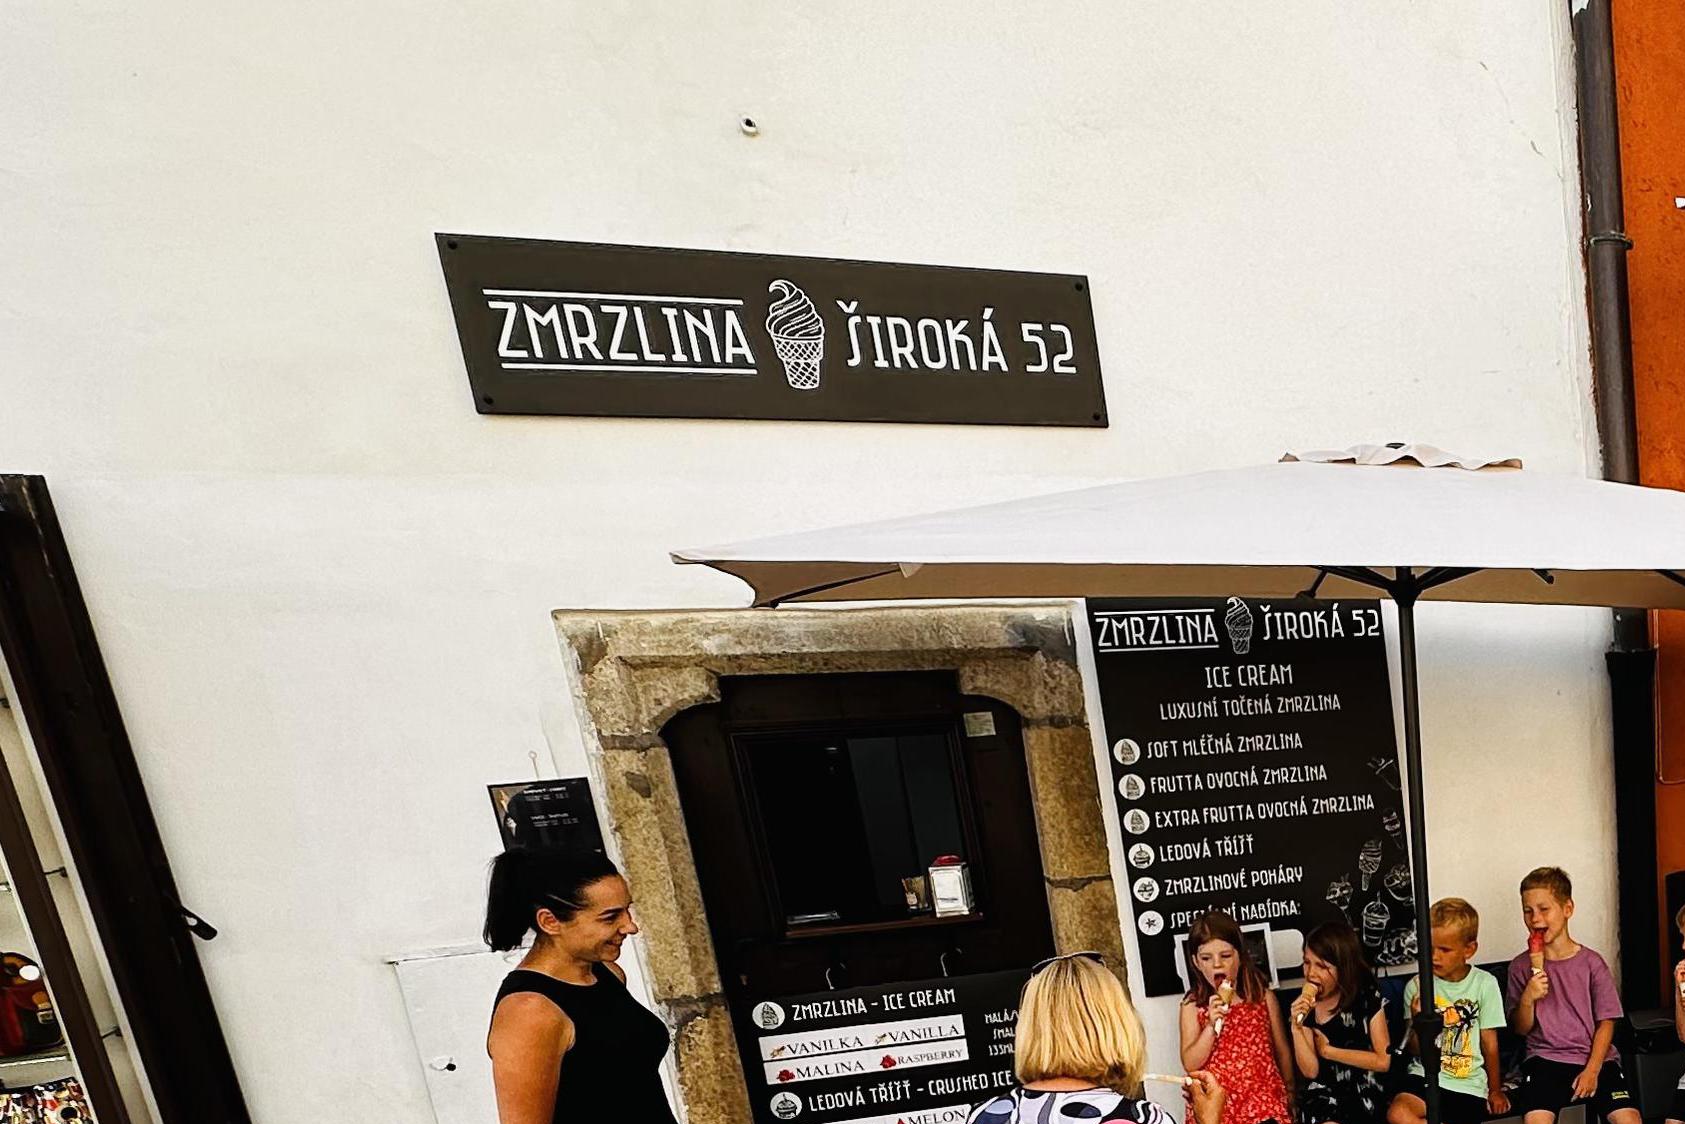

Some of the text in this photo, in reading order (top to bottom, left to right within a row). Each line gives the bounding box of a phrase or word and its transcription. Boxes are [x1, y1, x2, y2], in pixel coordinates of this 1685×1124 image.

[486, 298, 1077, 374] ZMRZLINA ŠIROKÁ 52
[1094, 601, 1380, 648] ZMRZLINA ŠIROKÁ 52
[1204, 663, 1294, 689] ICE CREAM
[1159, 693, 1342, 720] LUXUSNÍ TOČENÁ ZMRZLINA
[1146, 731, 1303, 760] SOFT MLÉČNÁ ZMRZLINA
[1150, 764, 1328, 795] FRUTTA OVOCNÁ ZMRZLINA
[1155, 793, 1376, 829] EXTRA FRUTTA OVOCNÁ ZMRZLINA
[1159, 833, 1255, 863] LEDOVÁ TŘÍŠŤ
[1163, 865, 1304, 896] ZMRZLINOVÉ POHÁRY
[791, 997, 868, 1022] ZMRZLINA
[882, 992, 906, 1012] ICE
[908, 988, 957, 1008] CREAM
[786, 1023, 961, 1057] VANILKA VANILLA
[796, 1049, 964, 1080] MALINA RASPBERRY
[809, 1086, 866, 1113] LEDOVÁ
[868, 1079, 912, 1104] TŘÍŠŤ
[928, 1074, 990, 1097] CRUSHED
[991, 1070, 1014, 1088] ICE
